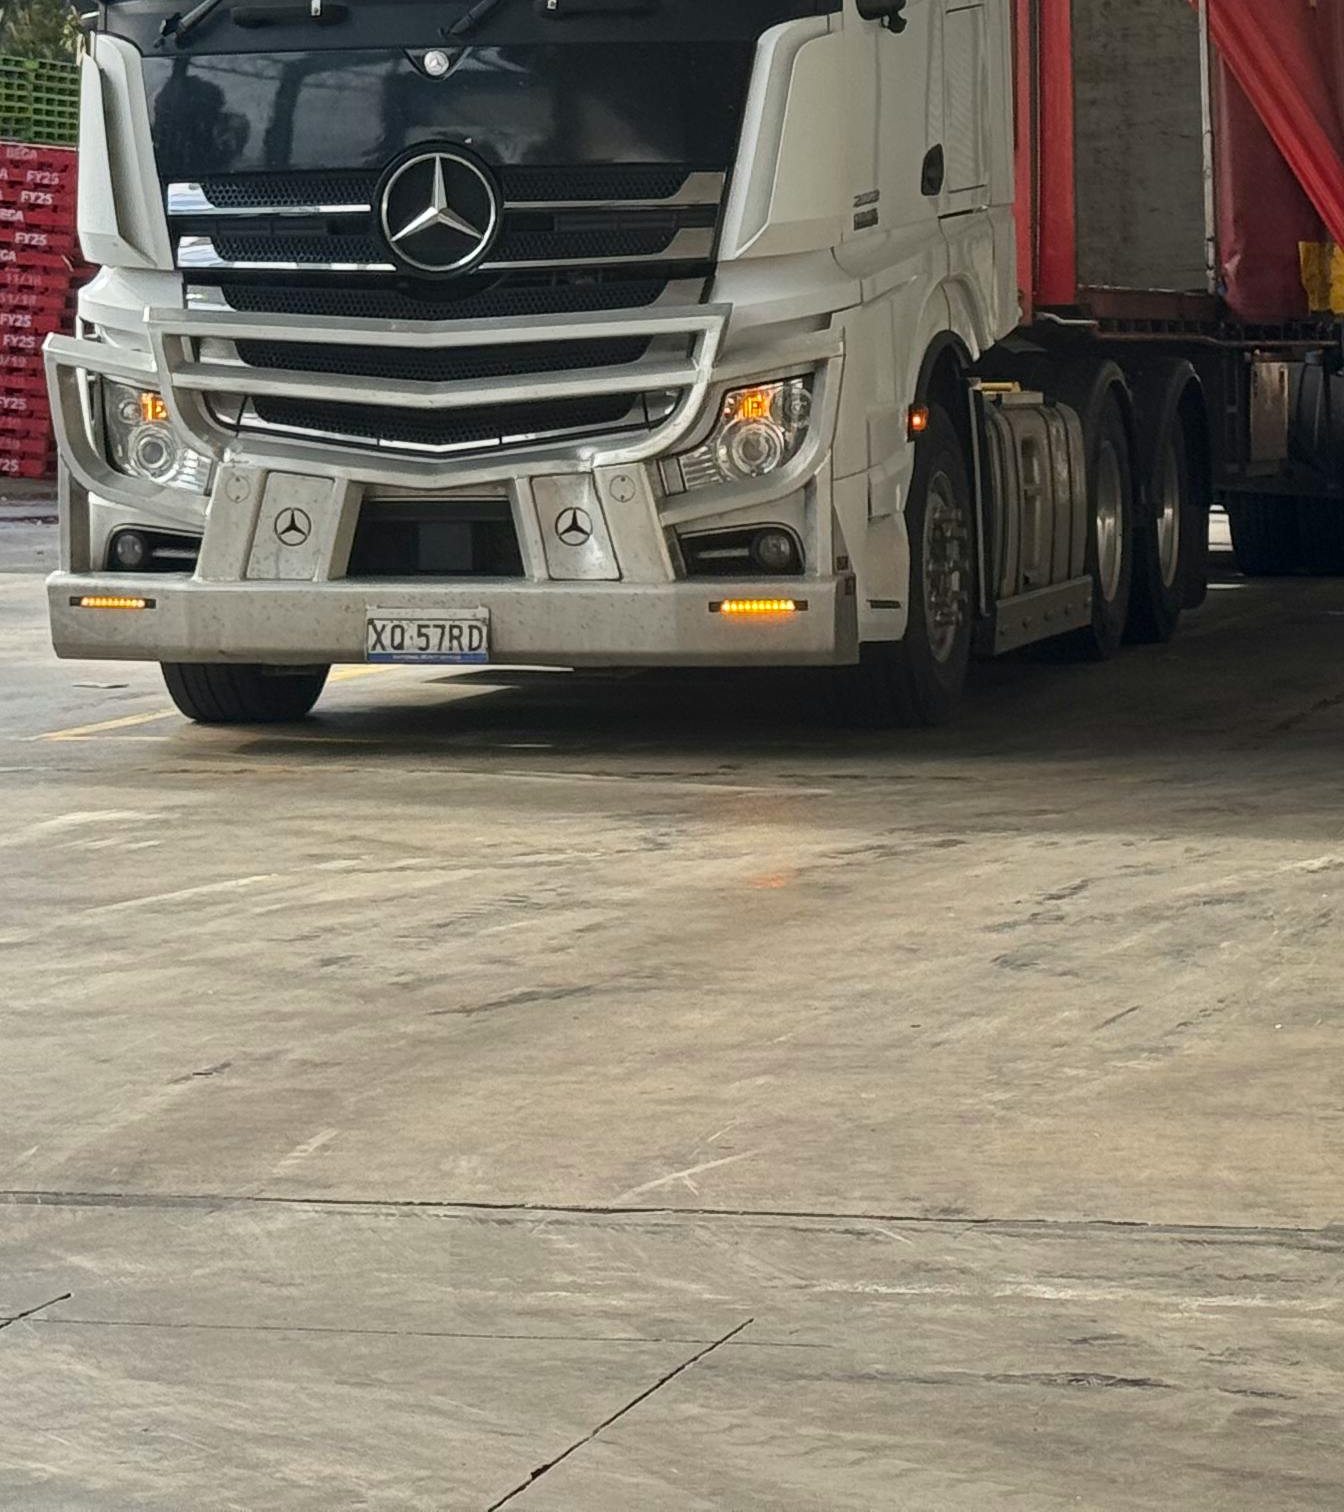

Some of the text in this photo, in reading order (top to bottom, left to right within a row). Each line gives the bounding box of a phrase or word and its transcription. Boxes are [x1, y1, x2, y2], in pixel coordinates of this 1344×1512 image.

[26, 170, 59, 185] FY25
[21, 190, 53, 205] FY25
[15, 232, 47, 246] FY25
[0, 313, 32, 328] FY25
[3, 334, 35, 348] FY25
